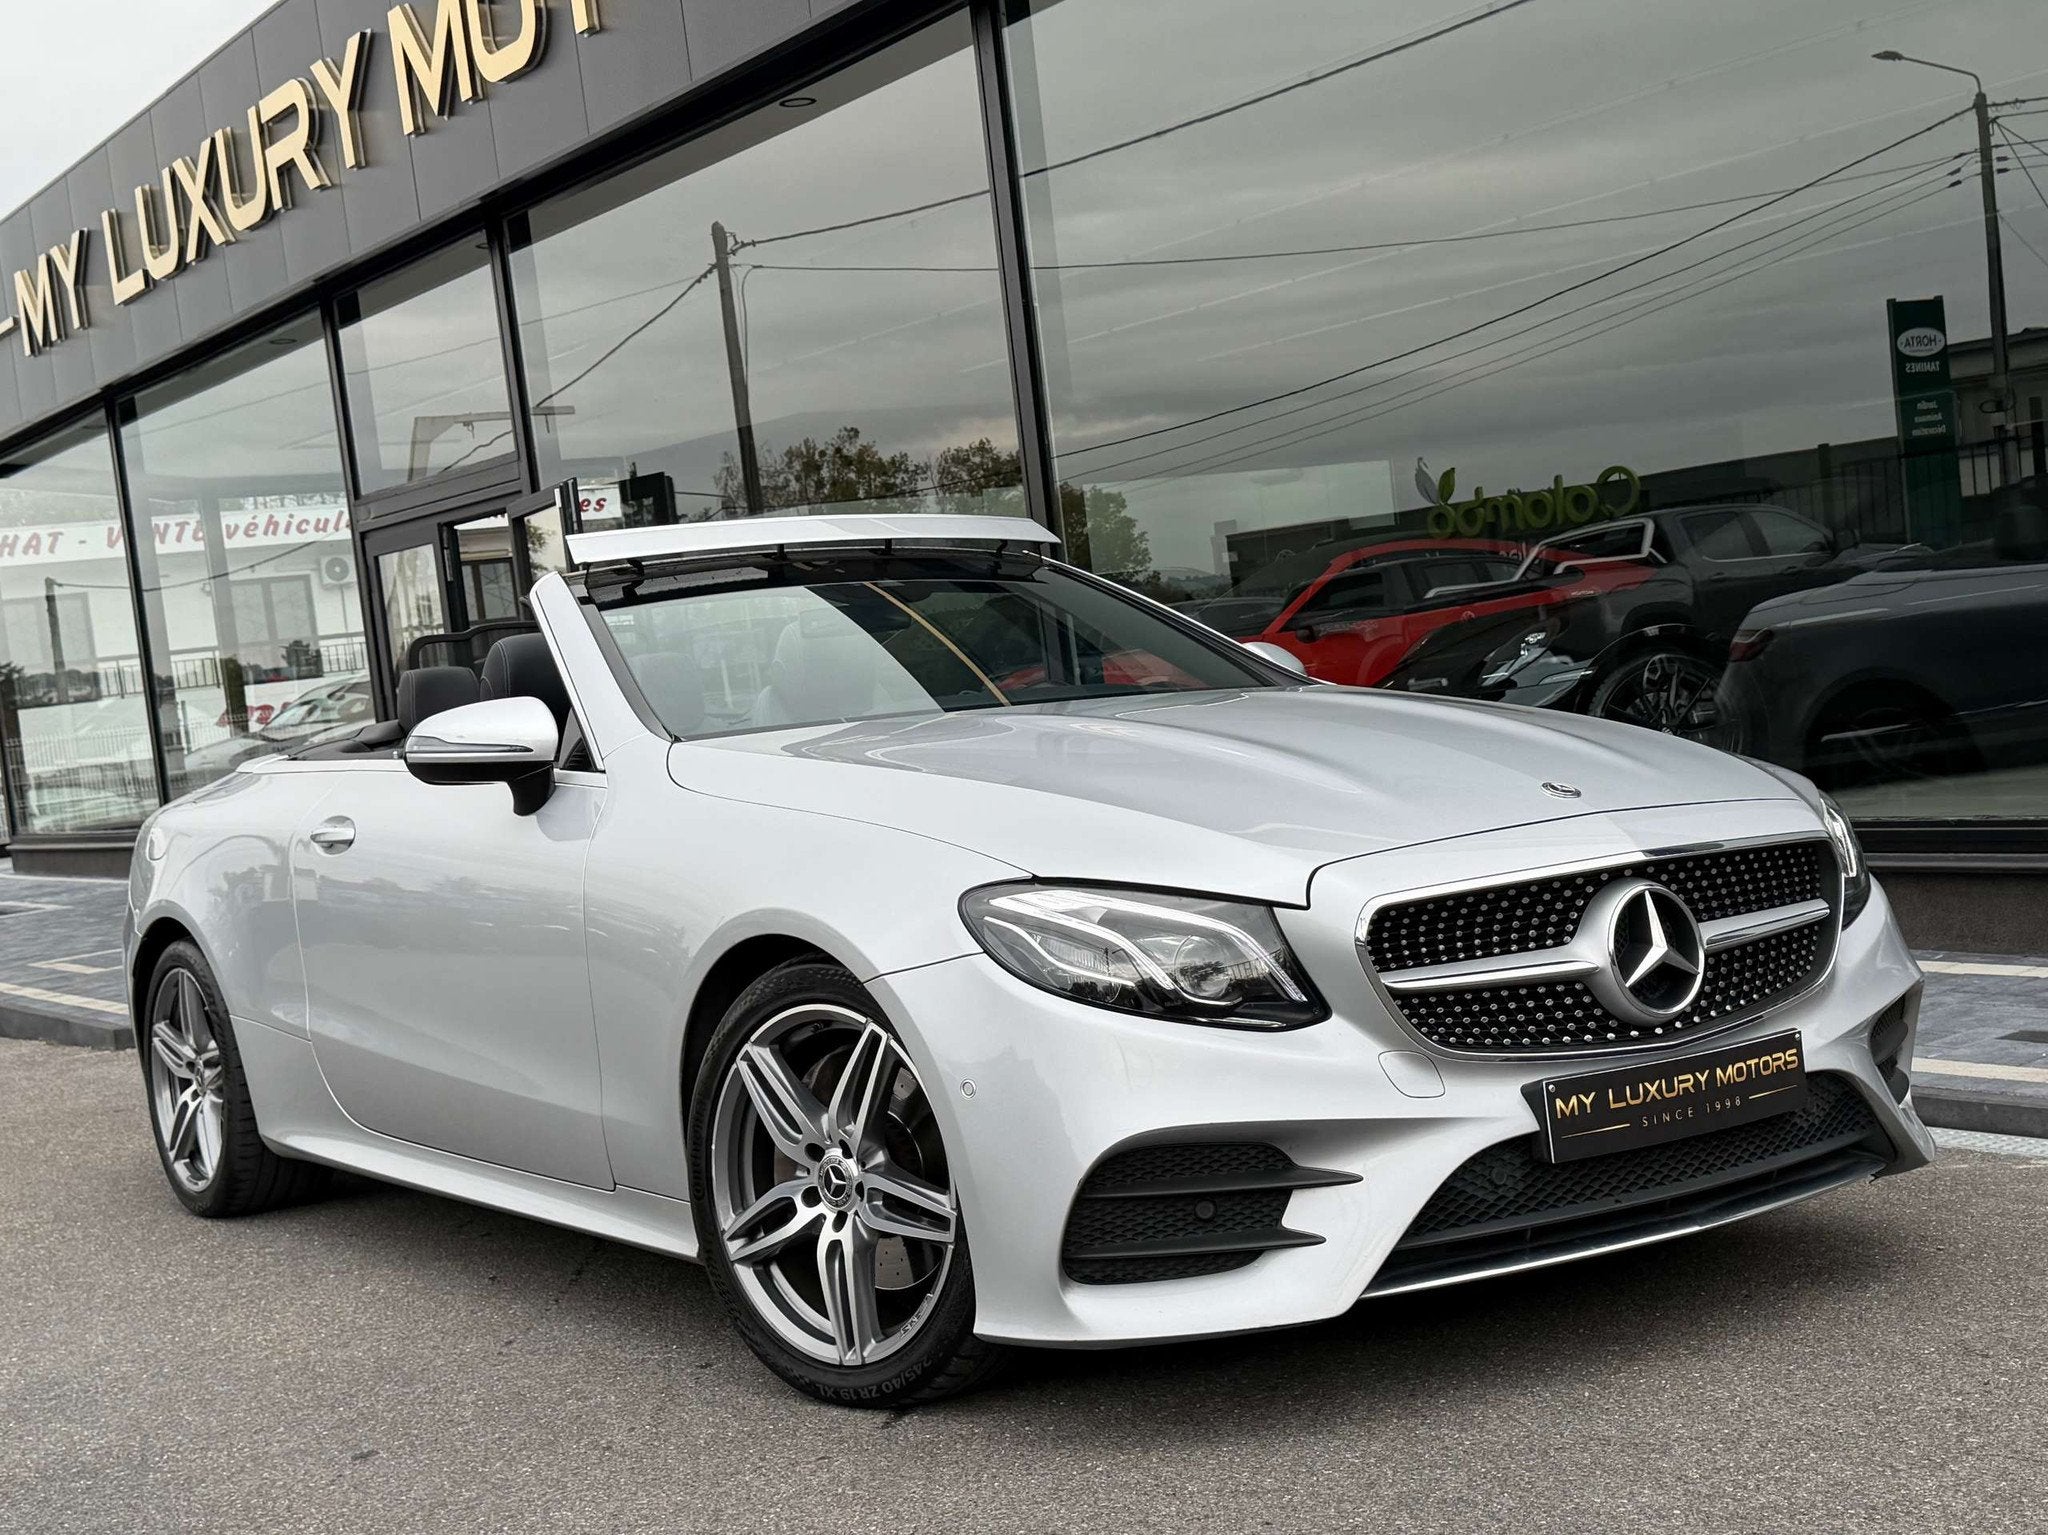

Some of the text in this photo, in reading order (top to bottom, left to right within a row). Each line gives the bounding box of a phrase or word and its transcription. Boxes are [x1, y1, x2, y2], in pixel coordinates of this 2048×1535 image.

[14, 228, 88, 357] MY
[101, 28, 373, 306] LUXURY
[1555, 1048, 1798, 1119] MY LUXURY MOTORS
[1641, 1096, 1742, 1127] SINCE 1998
